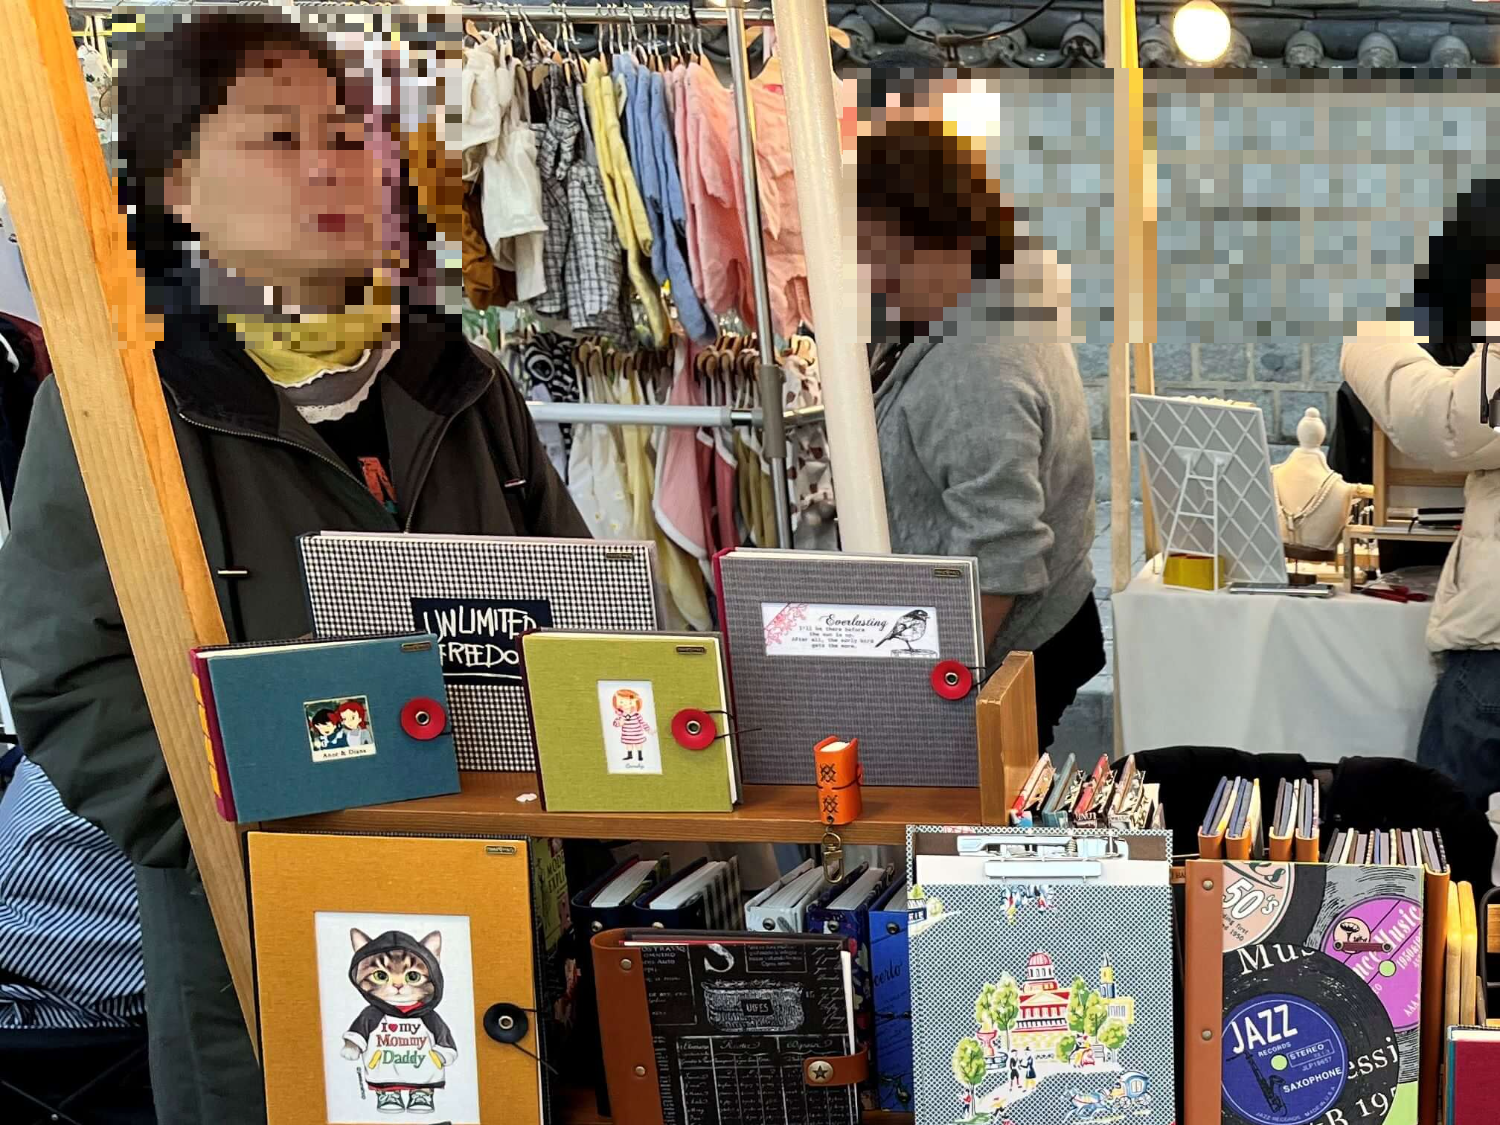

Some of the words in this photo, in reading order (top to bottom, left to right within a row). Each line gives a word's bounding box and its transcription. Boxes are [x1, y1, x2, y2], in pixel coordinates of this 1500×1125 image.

[423, 605, 537, 643] UNLIMITED
[819, 613, 887, 631] Everlasting
[438, 642, 519, 668] FREEDO
[381, 1022, 388, 1033] I
[399, 1022, 421, 1035] my
[1231, 1004, 1298, 1054] JAZZ
[376, 1034, 428, 1048] Mommy
[1257, 1041, 1292, 1058] RECORDS
[382, 1050, 427, 1069] Daddy
[1289, 1044, 1325, 1060] STEREO
[1283, 1066, 1343, 1093] SAXOPHONE
